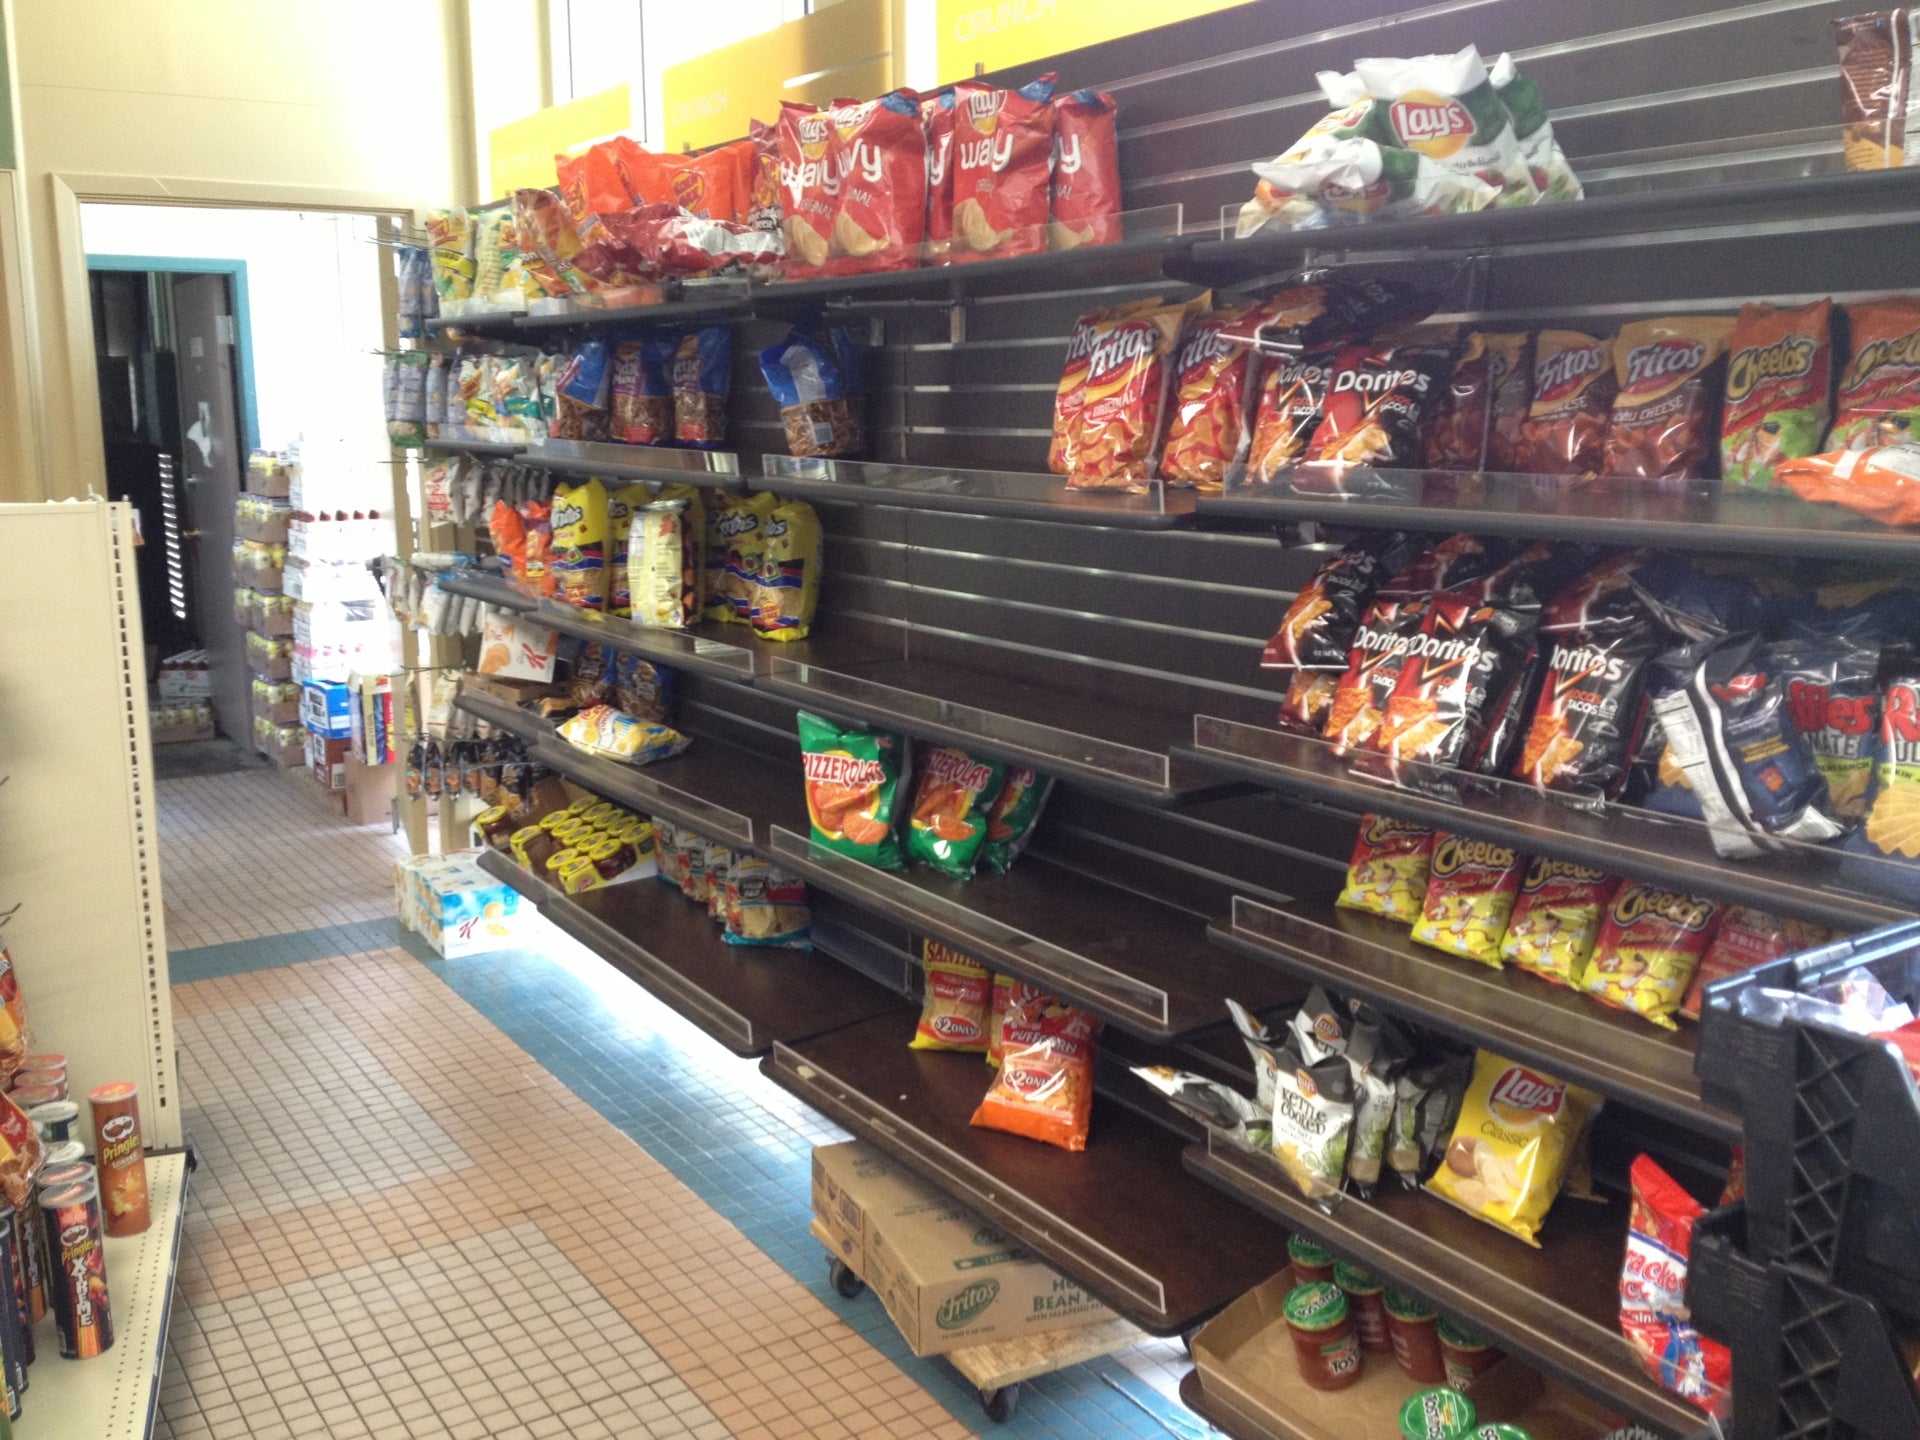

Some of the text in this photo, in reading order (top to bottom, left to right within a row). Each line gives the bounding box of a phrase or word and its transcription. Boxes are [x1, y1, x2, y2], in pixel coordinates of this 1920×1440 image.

[1400, 103, 1466, 141] Lay's
[1087, 326, 1160, 384] Fritos
[1627, 342, 1703, 387] Fritos
[1726, 337, 1813, 402] Cheetos
[1334, 369, 1431, 393] Doritos
[1353, 625, 1409, 656] Dorito
[1408, 633, 1497, 672] Doritos
[1568, 699, 1599, 715] TACOS
[801, 752, 887, 790] PIZZEROLAS
[1434, 835, 1515, 874] Cheetos
[1614, 884, 1712, 928] Cheetos
[1496, 1067, 1562, 1109] Lay's
[103, 1134, 139, 1165] Pringles
[1480, 1120, 1529, 1147] Classic
[1033, 1292, 1080, 1312] BEAN
